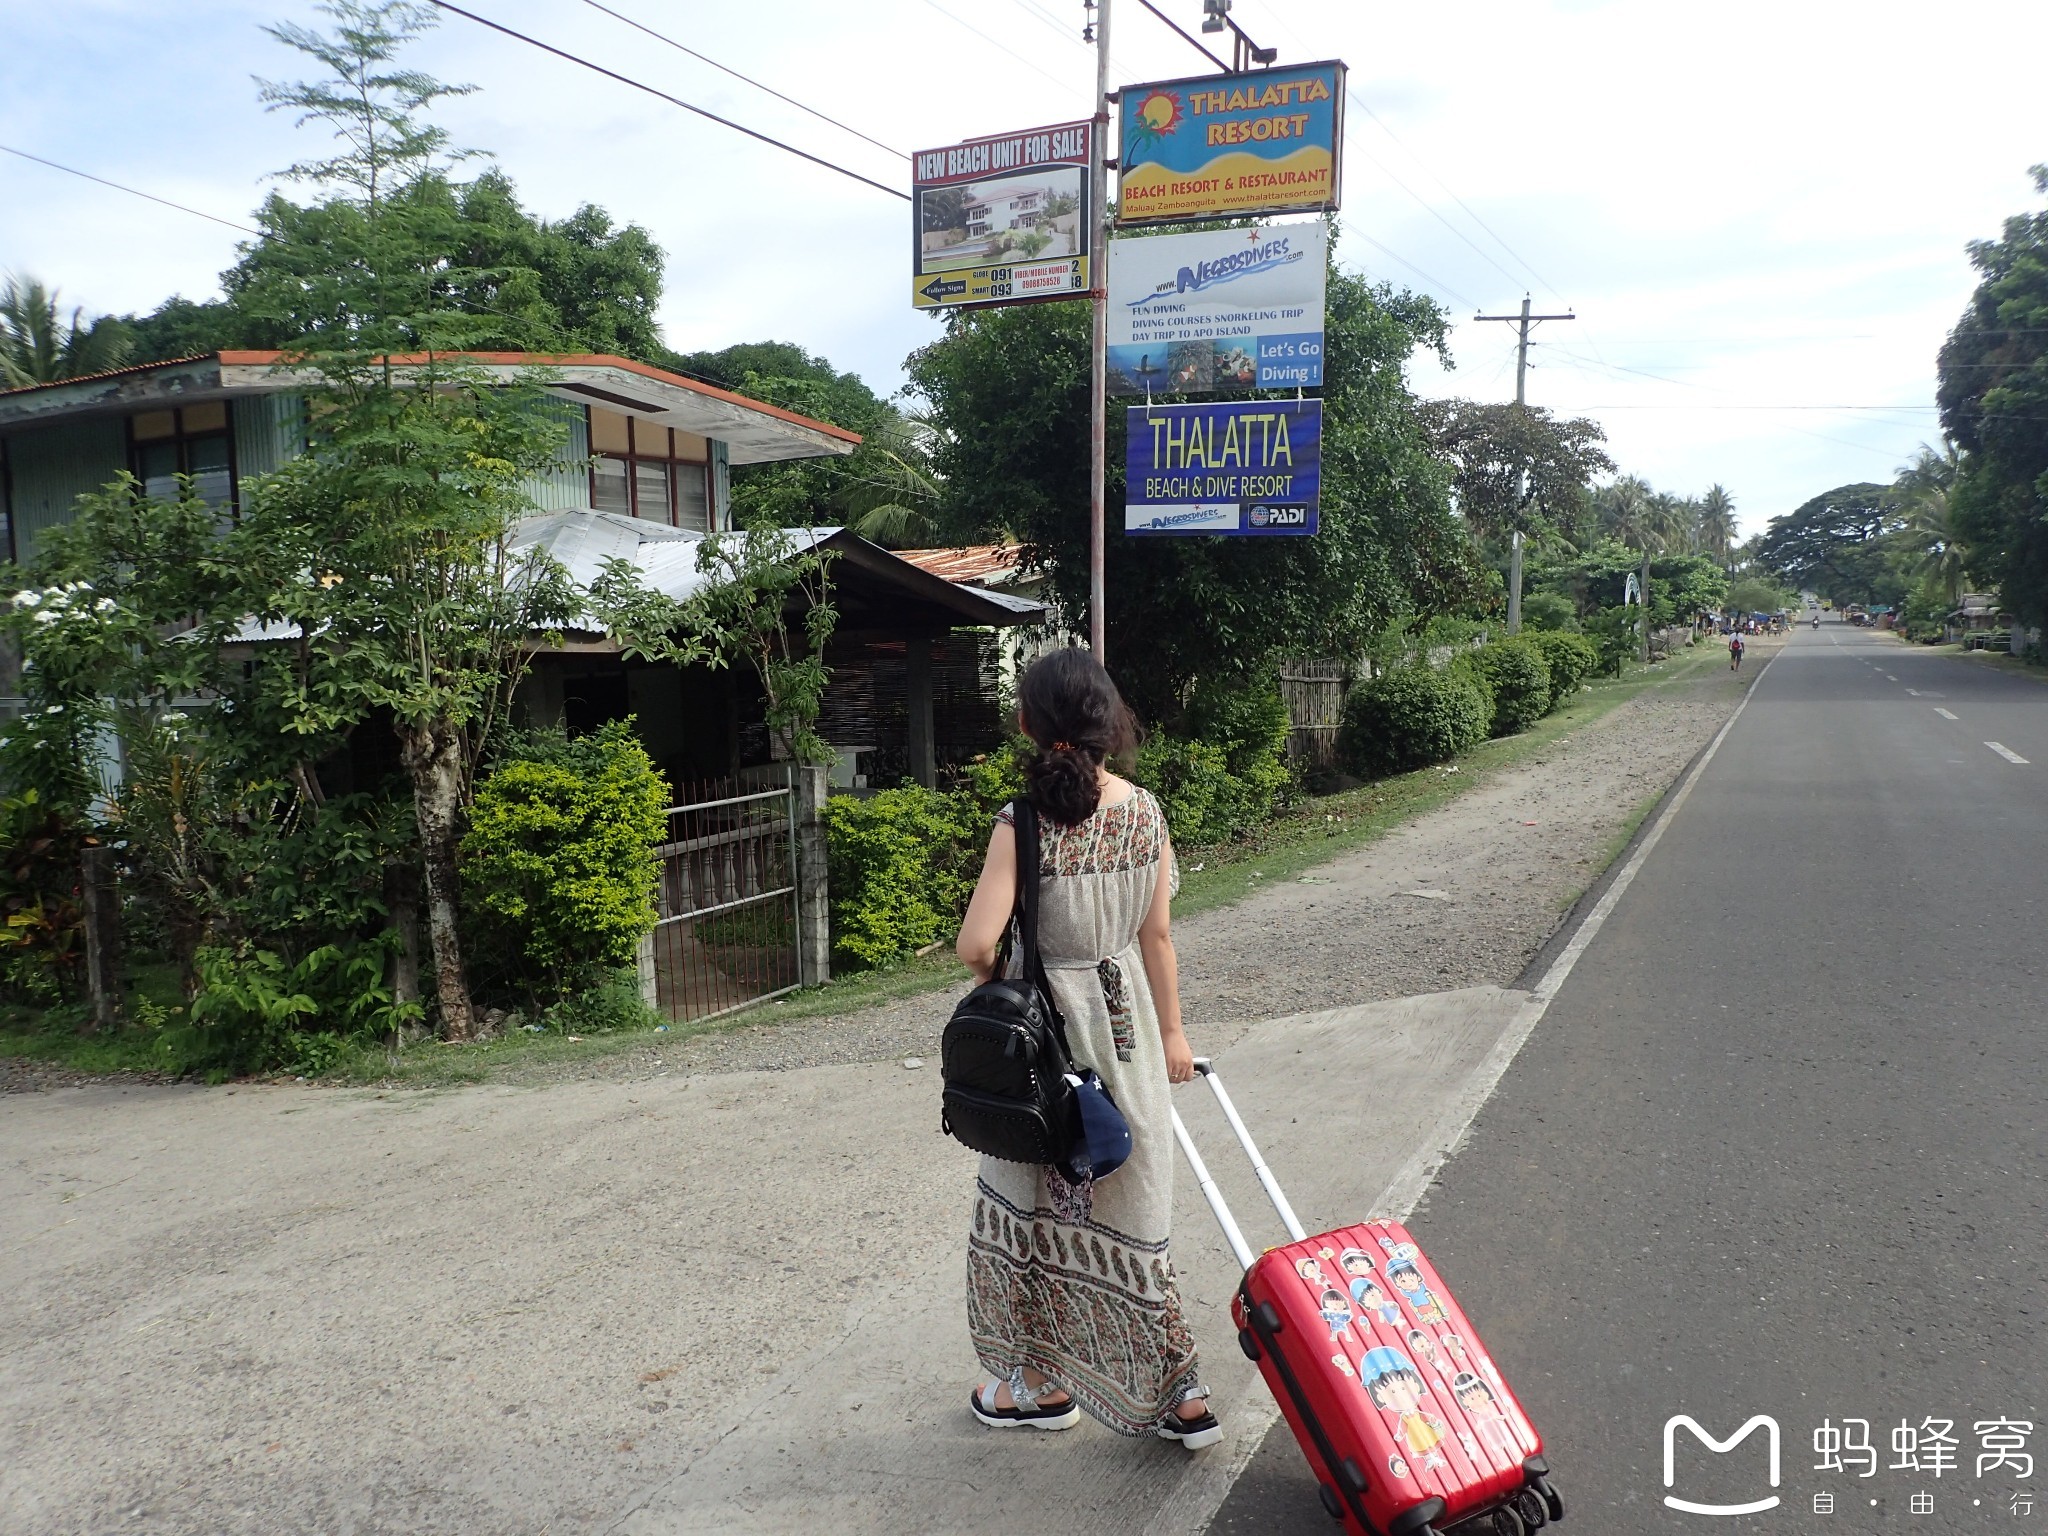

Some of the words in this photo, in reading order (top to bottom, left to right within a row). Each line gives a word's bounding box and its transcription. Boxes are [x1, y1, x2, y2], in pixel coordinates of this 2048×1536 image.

[1189, 78, 1330, 116] THALATTA
[1207, 114, 1309, 146] RESORT
[918, 152, 945, 180] NEW
[949, 145, 989, 176] BEACH
[992, 139, 1022, 169] UNIT
[1025, 135, 1049, 163] FOR
[1052, 129, 1084, 159] SALE
[1125, 184, 1166, 200] BEACH
[1172, 179, 1220, 195] RESORT
[1224, 178, 1234, 190] &
[1239, 168, 1328, 188] RESTAURANT
[1126, 202, 1155, 212] Maluay
[1157, 198, 1216, 210] Zamboanguita
[1223, 188, 1326, 204] www.thalattaresort.com
[973, 270, 988, 278] GLOBE
[1048, 265, 1068, 274] NUMBER
[926, 284, 946, 294] Follow
[947, 283, 964, 292] Signs
[972, 286, 990, 295] SMART
[1132, 307, 1150, 316] FUN
[1154, 304, 1186, 314] DIVING
[1132, 318, 1164, 328] DIVING
[1168, 315, 1212, 326] COURSES
[1214, 311, 1277, 324] SNORKELING
[1281, 309, 1304, 318] TRIP
[1132, 332, 1150, 342] DAY
[1154, 330, 1174, 340] TRIP
[1178, 329, 1190, 338] TO
[1194, 328, 1212, 337] APO
[1216, 326, 1250, 336] ISLAND
[1261, 342, 1294, 358] Let's
[1299, 342, 1320, 356] Go
[1148, 414, 1292, 469] THALATTA
[1146, 477, 1188, 498] BEACH
[1192, 476, 1202, 498] &
[1206, 476, 1237, 497] DIVE
[1241, 476, 1292, 496] RESORT
[1270, 508, 1305, 524] PADI
